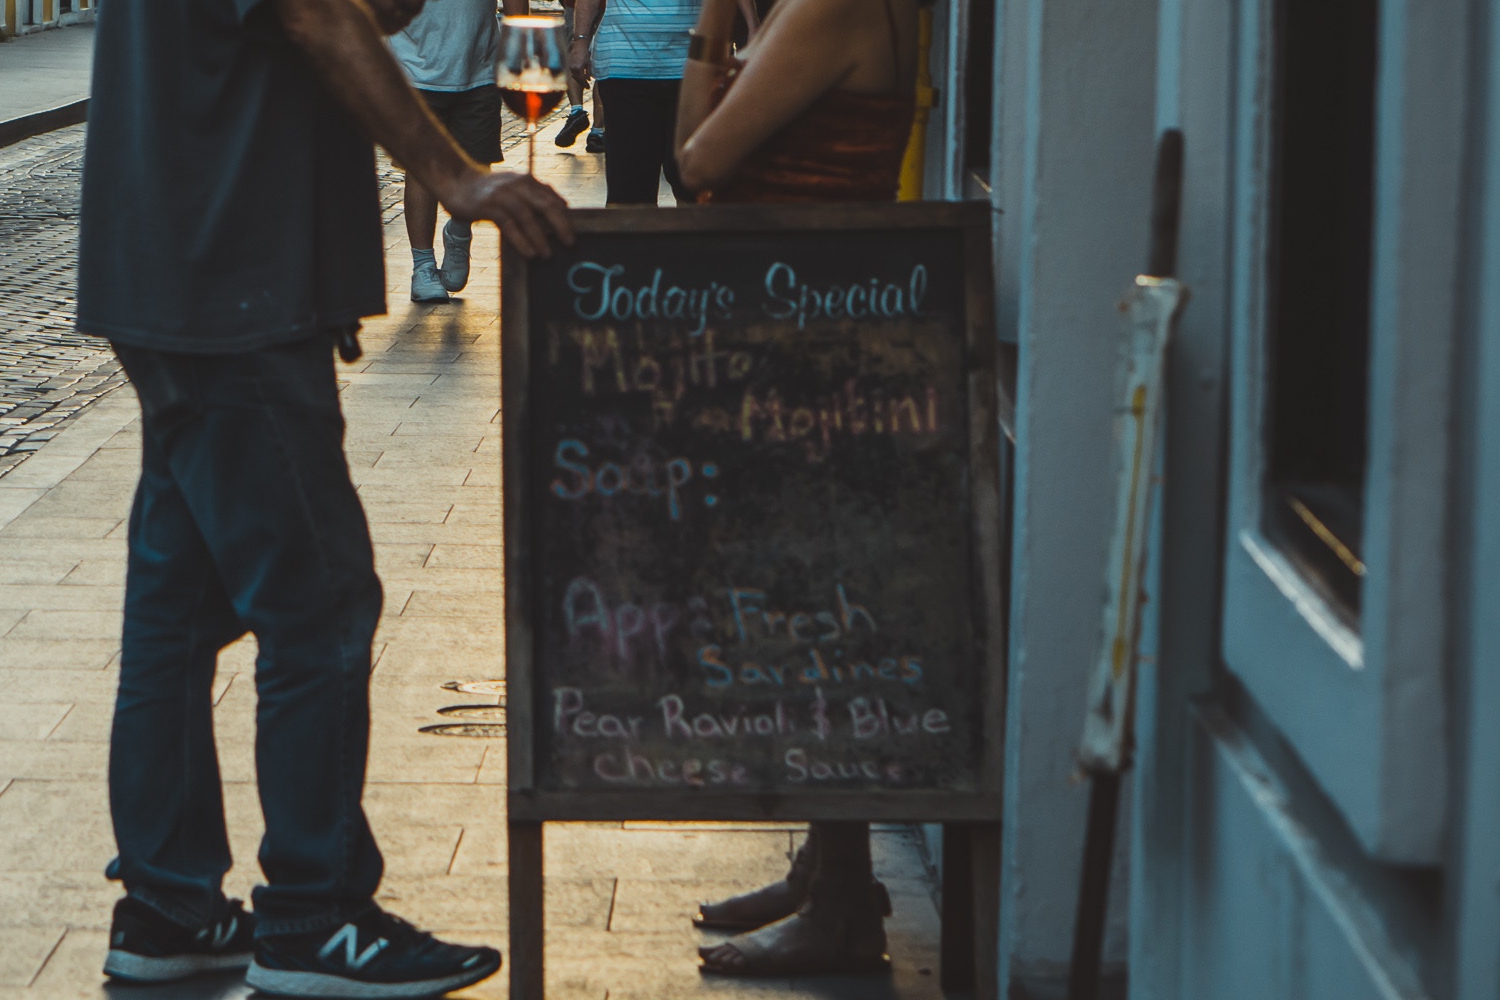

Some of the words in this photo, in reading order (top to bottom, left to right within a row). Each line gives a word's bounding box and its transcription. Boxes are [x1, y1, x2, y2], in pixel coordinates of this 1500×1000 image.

[567, 261, 735, 337] Today's
[761, 261, 928, 331] Special
[726, 582, 878, 641] Fresh
[699, 644, 923, 688] Sardines
[552, 686, 643, 738] Pear
[848, 697, 951, 740] Blue
